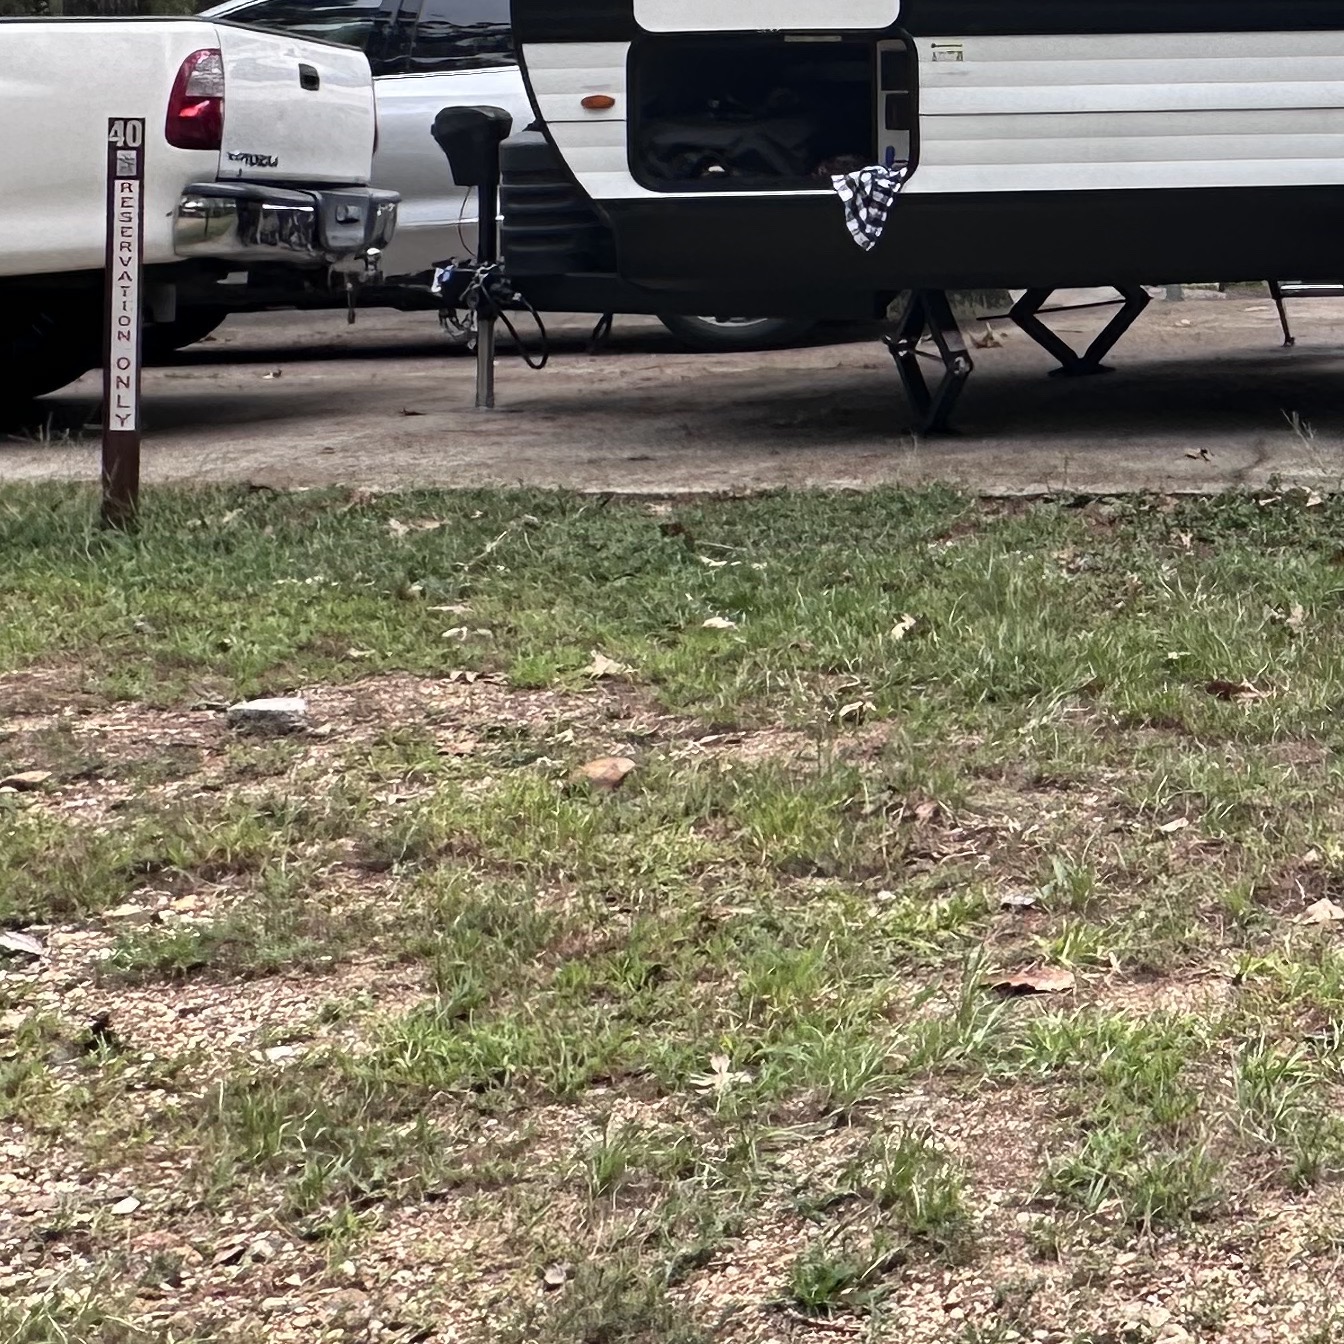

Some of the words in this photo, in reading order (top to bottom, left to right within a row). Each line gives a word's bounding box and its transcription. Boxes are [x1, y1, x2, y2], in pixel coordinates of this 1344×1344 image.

[108, 119, 143, 148] 40
[117, 181, 135, 342] RESERVATION
[115, 356, 132, 427] ONLY
